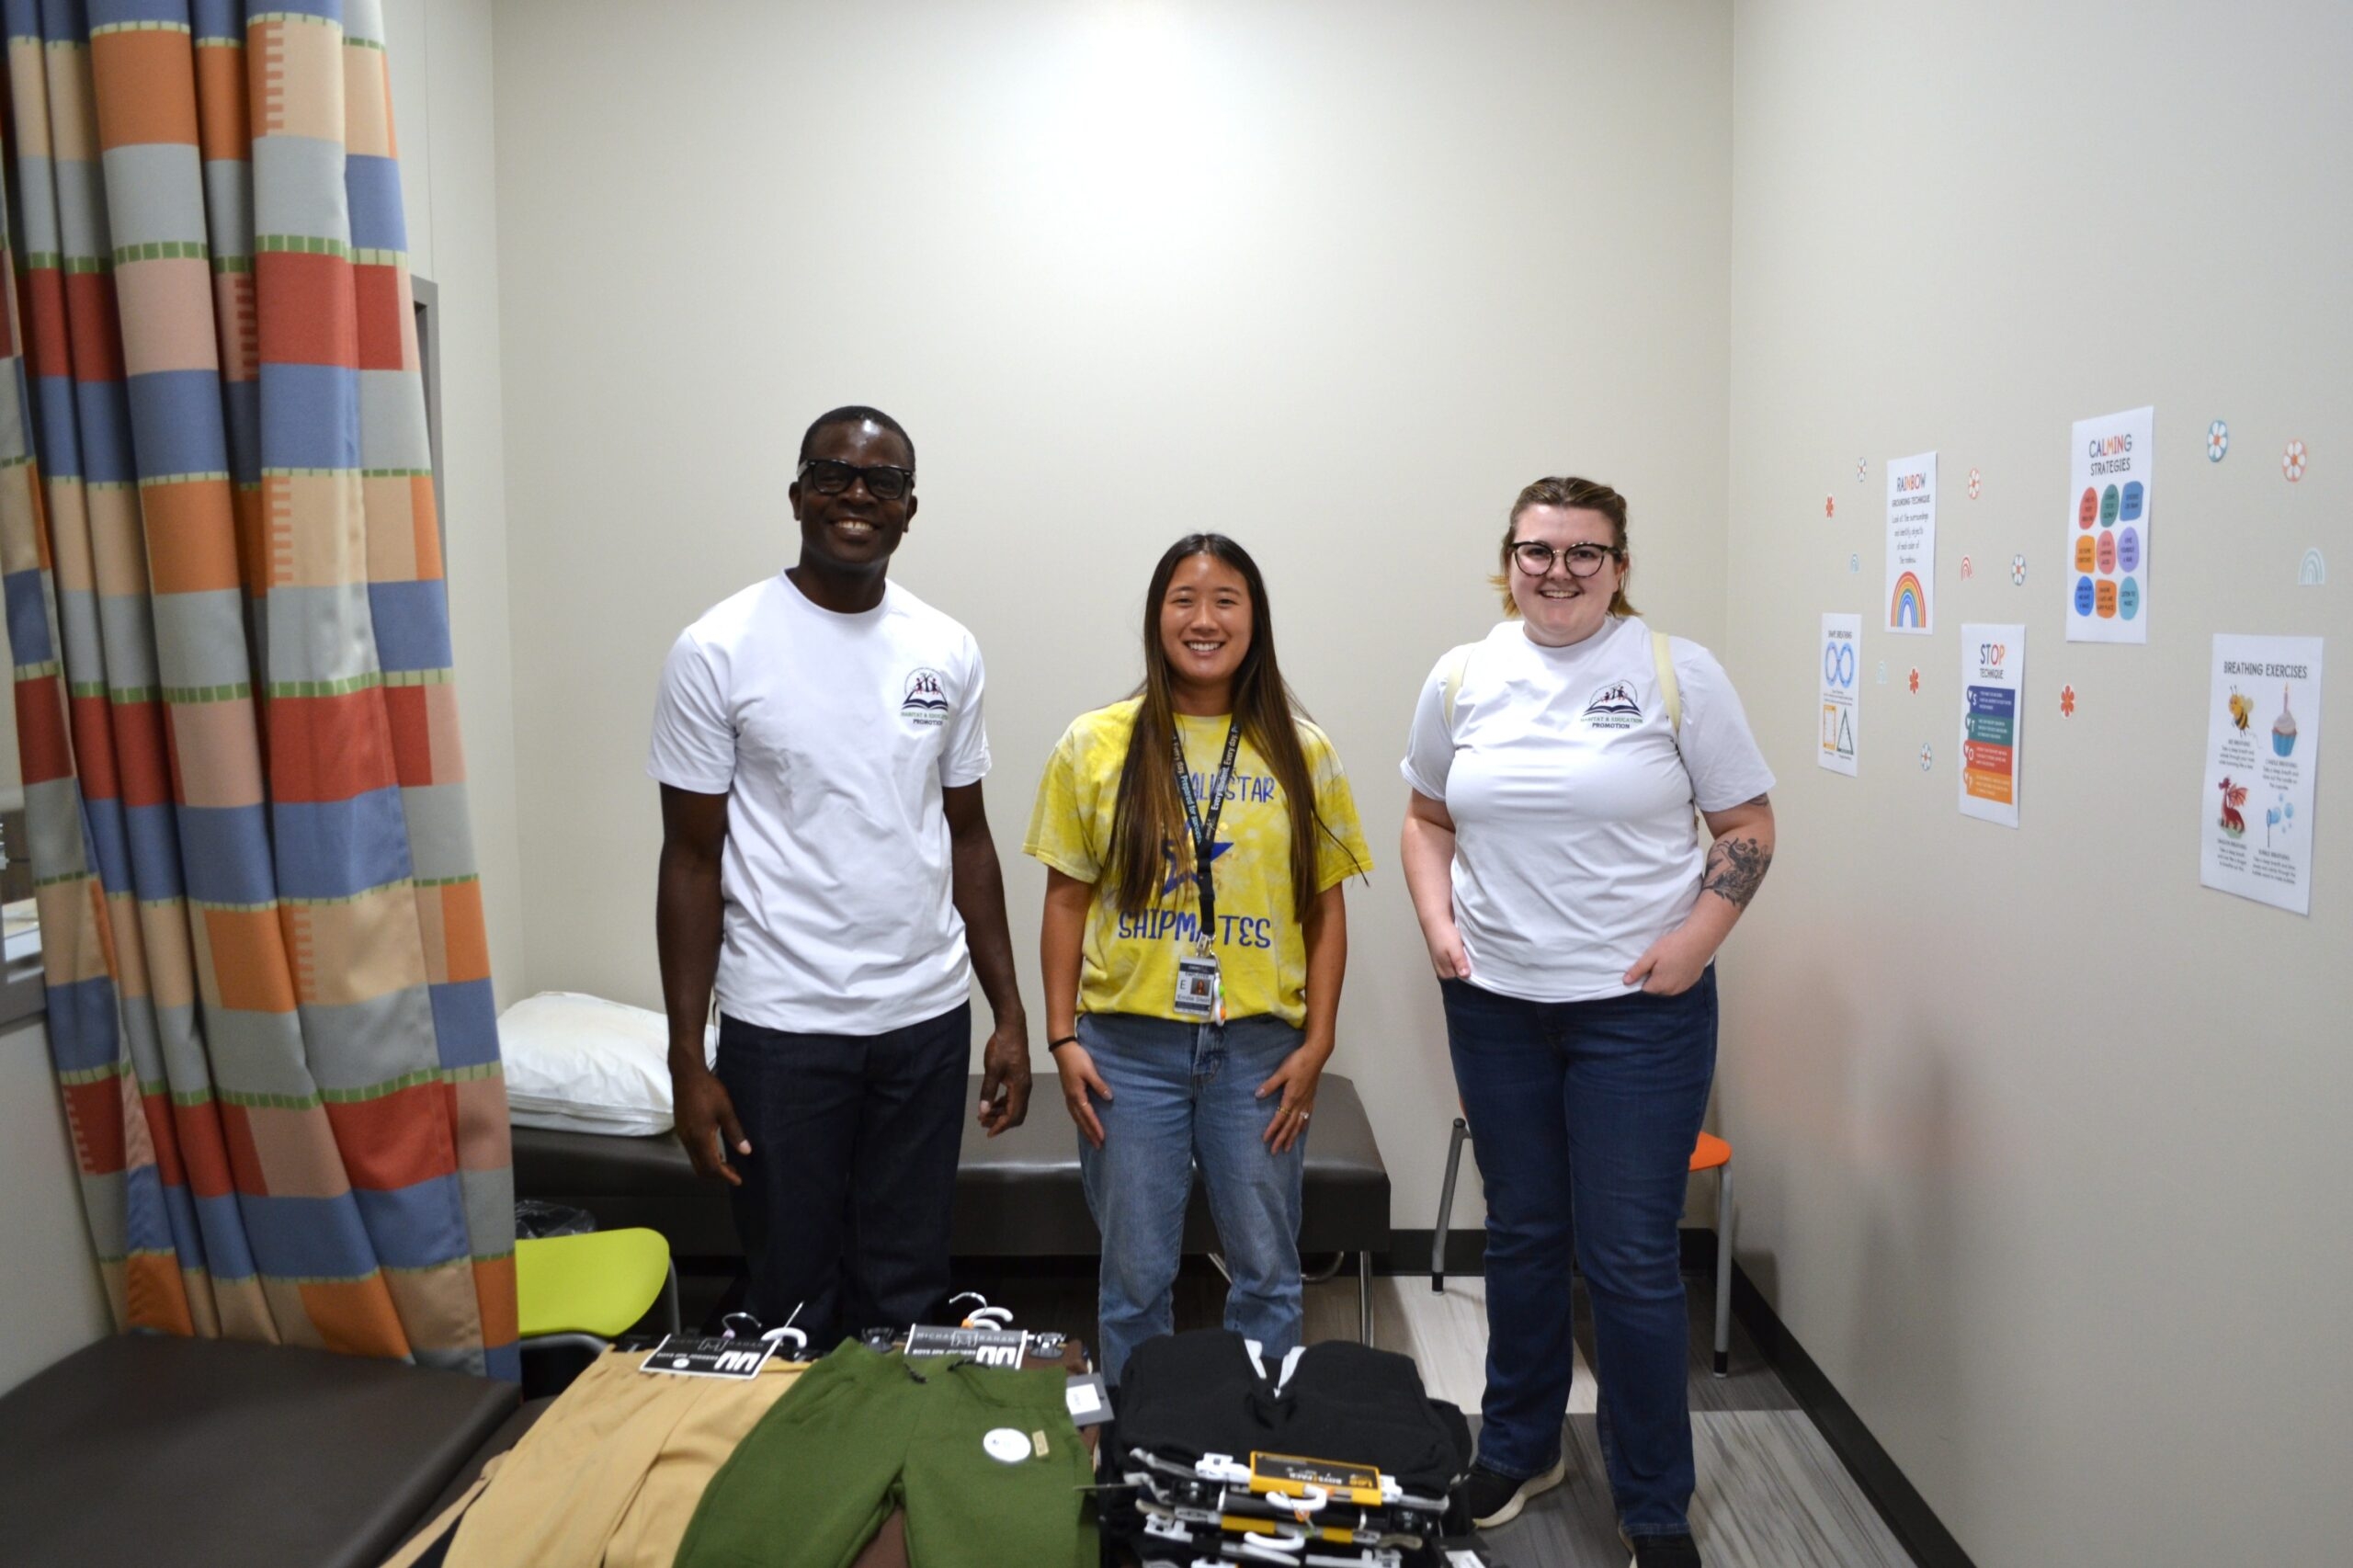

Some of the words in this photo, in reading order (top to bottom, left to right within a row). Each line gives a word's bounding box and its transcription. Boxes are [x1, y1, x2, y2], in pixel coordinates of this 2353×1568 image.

[2089, 434, 2132, 458] CALMING
[2090, 458, 2131, 476] STRATEGIES
[1897, 472, 1927, 492] RAINBOW
[1980, 644, 2005, 665] STOP
[1980, 668, 2004, 679] TECHNIQUE
[2223, 661, 2263, 676] BREATHING
[2266, 663, 2308, 679] EXERCISES
[1972, 693, 1977, 706] S
[1969, 748, 1973, 761] O
[1211, 790, 1223, 811] Every
[1223, 744, 1235, 766] Every
[1180, 775, 1194, 805] Prepared
[1224, 775, 1276, 803] STAR
[1119, 908, 1271, 949] SHIPMTES
[1180, 980, 1187, 990] E
